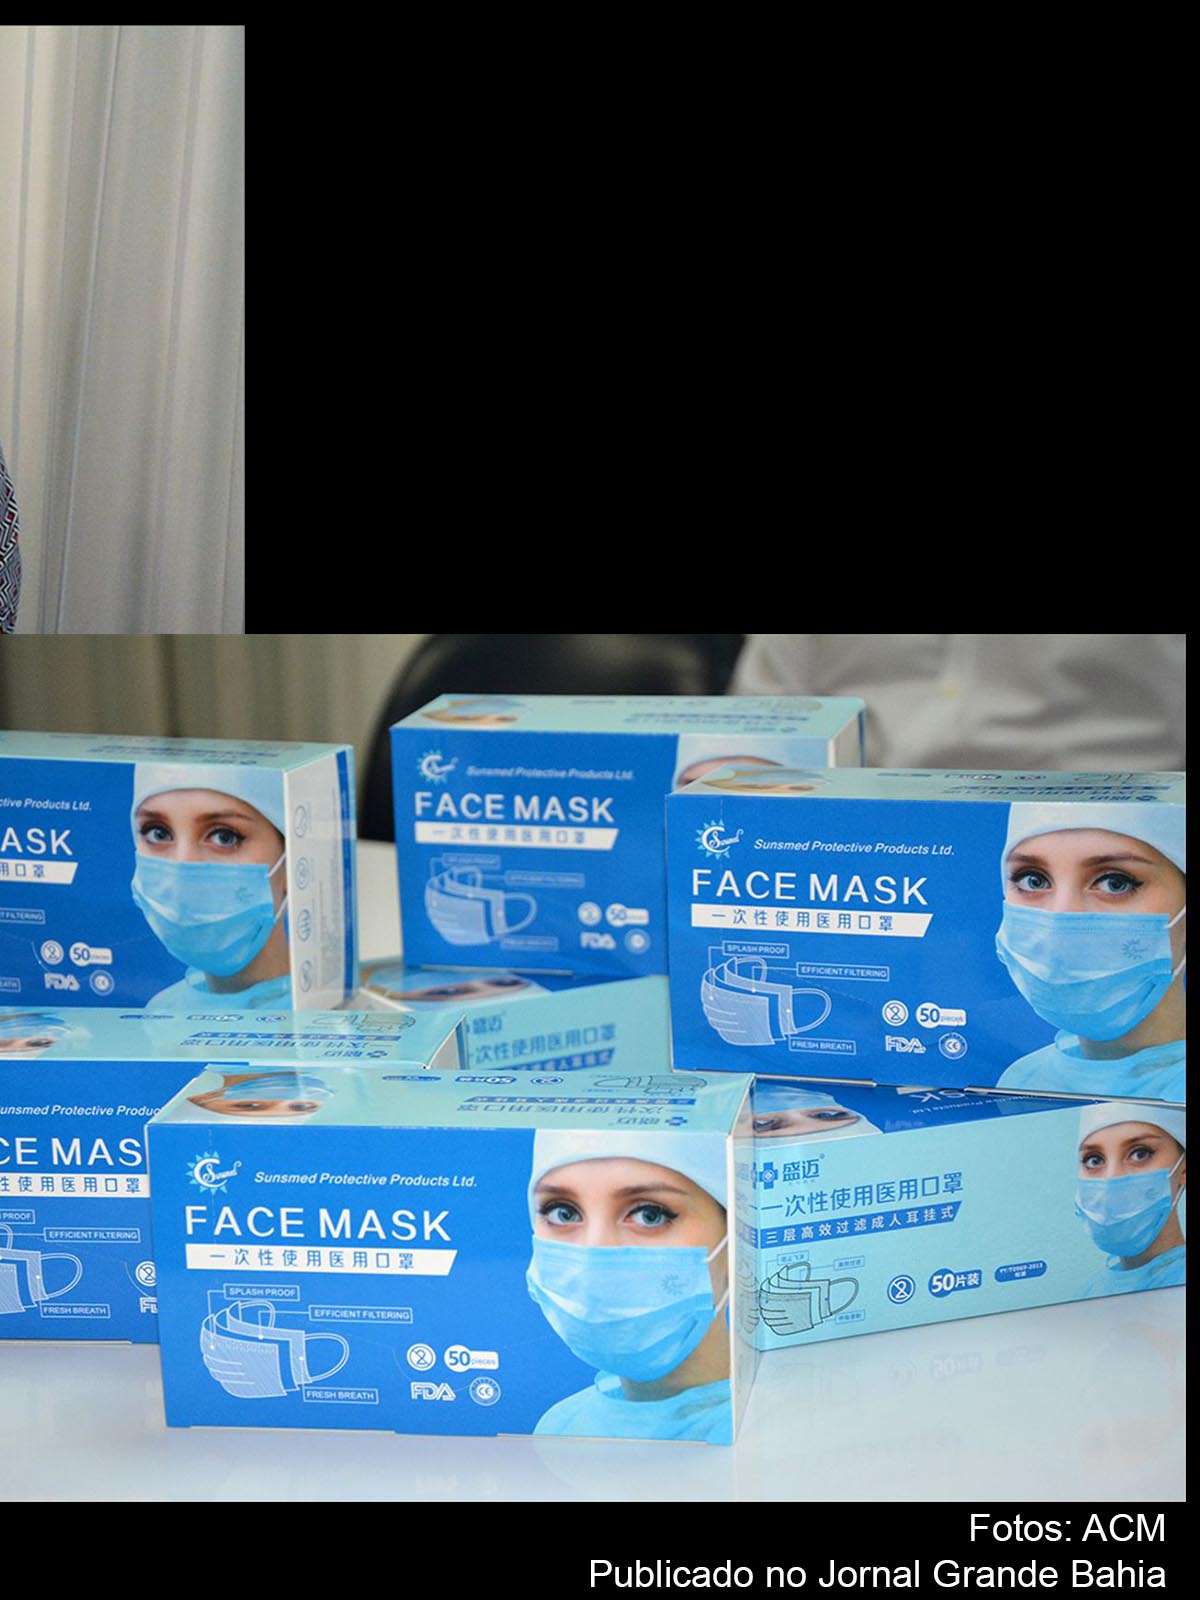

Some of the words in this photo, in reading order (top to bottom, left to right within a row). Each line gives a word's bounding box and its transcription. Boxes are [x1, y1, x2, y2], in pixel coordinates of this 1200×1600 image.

[466, 766, 514, 778] Sunsmed
[515, 767, 566, 778] Protective
[568, 768, 613, 780] Products
[615, 770, 634, 780] Ltd.
[24, 799, 70, 810] Products
[72, 800, 92, 812] Ltd.
[414, 791, 504, 820] FACE
[514, 795, 615, 823] MASK
[754, 839, 810, 851] Sunsmed
[812, 841, 872, 853] Protective
[875, 842, 929, 855] Products
[932, 845, 954, 856] Ltd.
[692, 869, 797, 900] FACE
[810, 874, 928, 906] MASK
[6, 911, 42, 920] FILTERING
[712, 909, 894, 932] 一次性使用医用口罩
[580, 932, 616, 950] FDA
[73, 948, 90, 961] 50
[728, 944, 758, 953] SPLASH
[759, 946, 786, 954] PROOF
[801, 966, 842, 976] EFFICIENT
[844, 968, 887, 978] FILTERING
[44, 973, 80, 990] FDA
[920, 1007, 940, 1022] 50
[468, 1024, 615, 1064] 次性使用医用口罩
[792, 1041, 819, 1049] FRESH
[820, 1042, 852, 1050] BREATH
[885, 1034, 926, 1054] FDA
[50, 1105, 114, 1116] Protective
[52, 1138, 142, 1166] MAS
[783, 1158, 820, 1182] 盛迈
[254, 1172, 318, 1184] Sunsmed
[319, 1173, 387, 1186] Protective
[390, 1174, 450, 1187] Products
[452, 1176, 477, 1188] Ltd.
[761, 1172, 963, 1216] 一次性使用医用口罩
[2, 1212, 32, 1221] PROOF
[186, 1206, 304, 1238] FACE
[319, 1208, 451, 1241] MASK
[766, 1206, 954, 1244] 三层高效过滤成人耳挂式
[49, 1231, 92, 1240] EFFICIENT
[93, 1232, 138, 1240] FILTERING
[210, 1248, 414, 1270] 一次性使用医用口罩
[230, 1287, 264, 1296] SPLASH
[265, 1288, 296, 1297] PROOF
[44, 1306, 72, 1314] FRESH
[314, 1309, 361, 1318] EFFICIENT
[362, 1310, 410, 1320] FILTERING
[449, 1351, 470, 1366] 50
[306, 1390, 337, 1398] FRESH
[338, 1392, 374, 1400] BREATH
[410, 1382, 456, 1401] FDA
